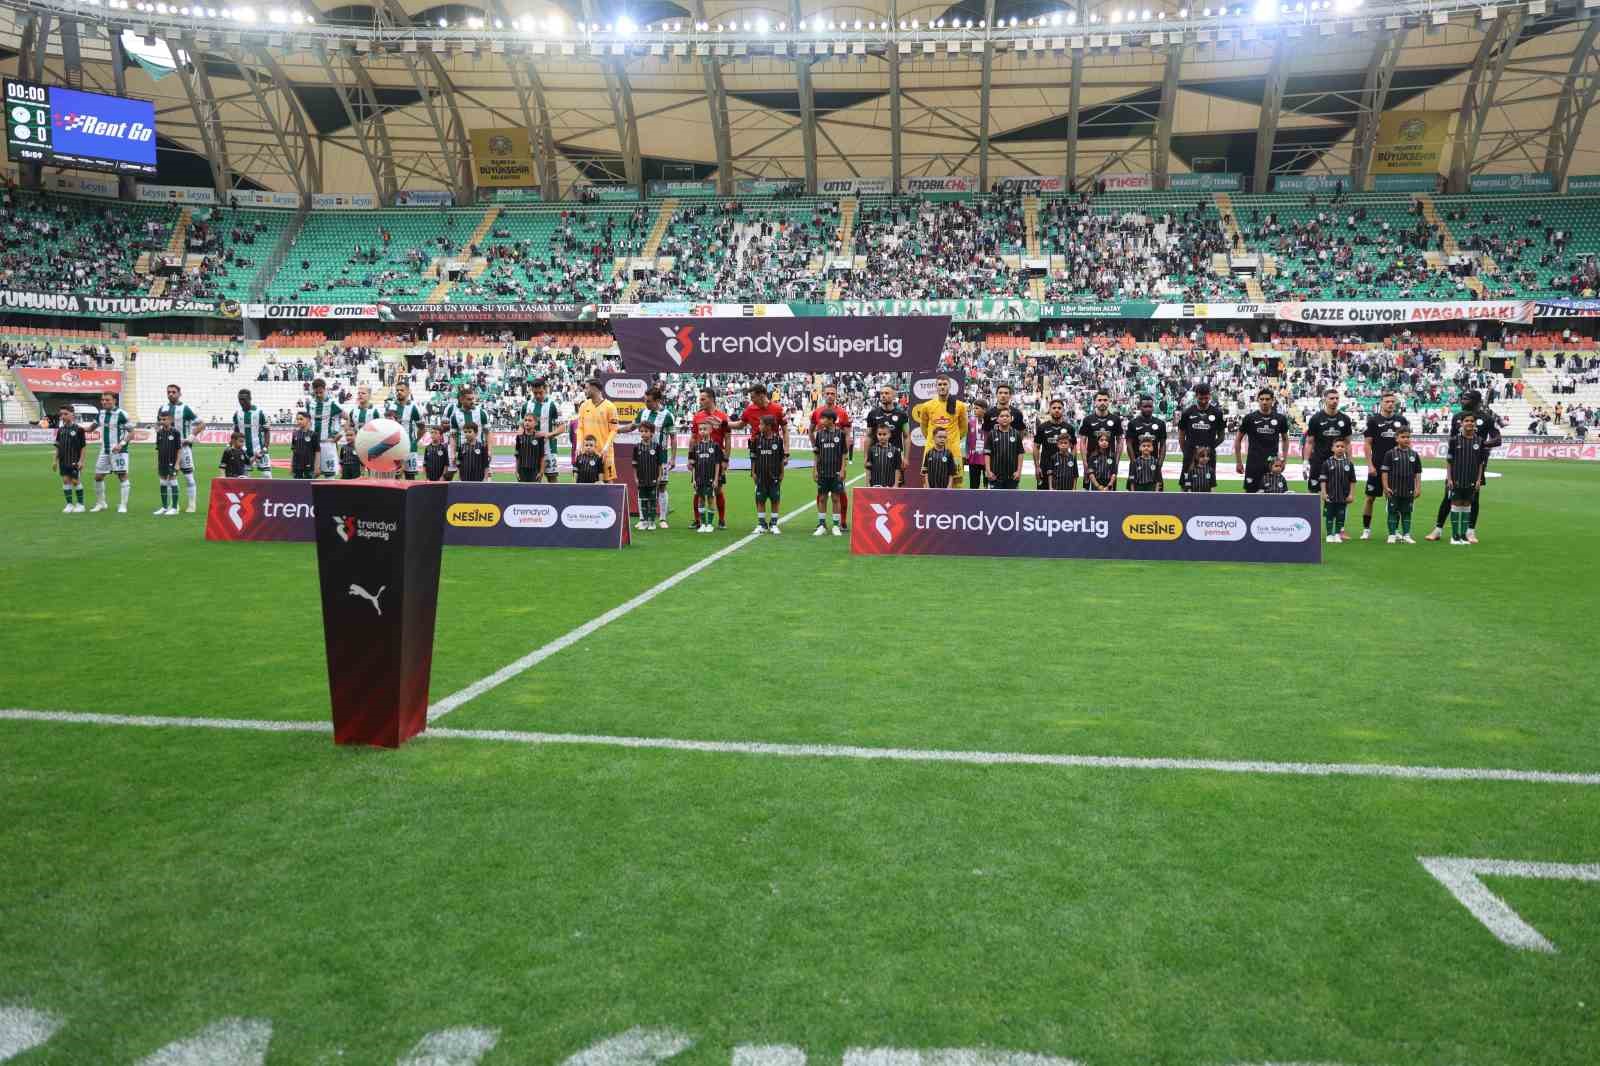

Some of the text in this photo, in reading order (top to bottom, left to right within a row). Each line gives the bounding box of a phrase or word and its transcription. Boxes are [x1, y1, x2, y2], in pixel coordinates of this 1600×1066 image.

[7, 83, 45, 100] 00:00
[36, 110, 46, 125] 0
[37, 126, 47, 142] 0
[81, 114, 152, 142] Rent Go
[1301, 308, 1344, 321] GAZZE
[698, 331, 809, 358] trendyol
[116, 458, 126, 466] 10
[453, 509, 494, 522] NESİNE
[513, 507, 550, 516] trendyol
[357, 520, 397, 531] trendyol
[914, 510, 1019, 535] trendyol
[1130, 522, 1176, 535] NESİNE
[1196, 520, 1237, 529] trendyol
